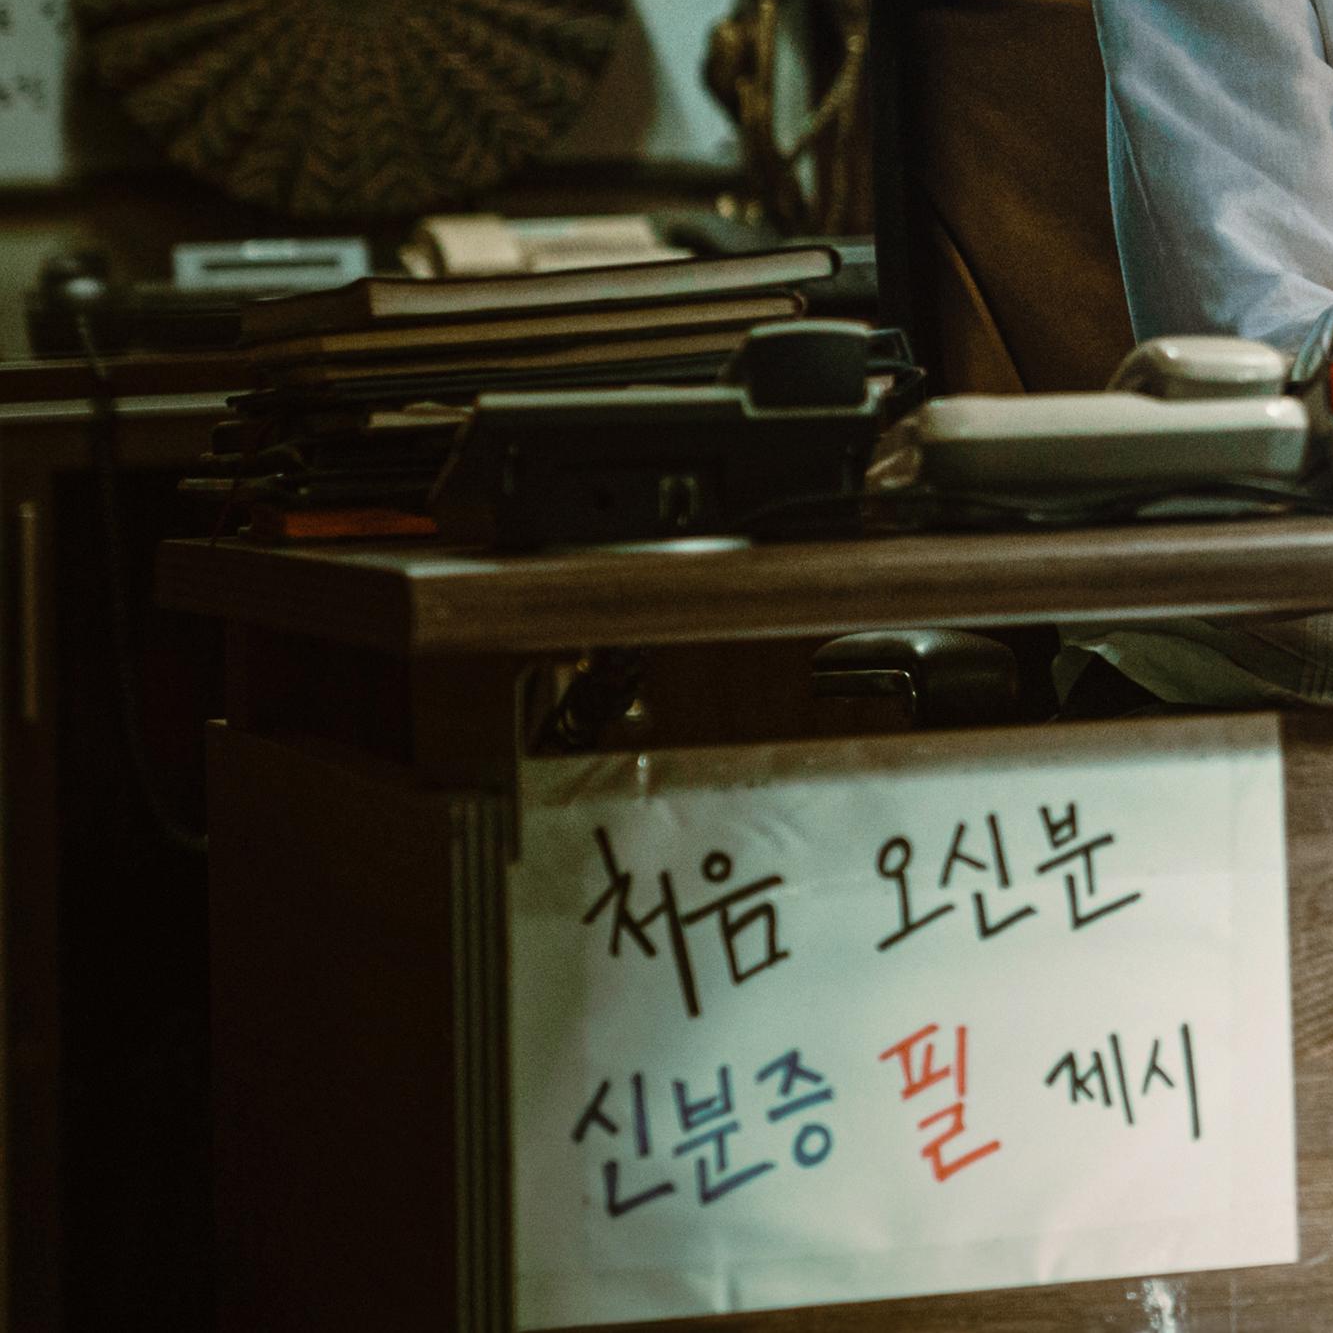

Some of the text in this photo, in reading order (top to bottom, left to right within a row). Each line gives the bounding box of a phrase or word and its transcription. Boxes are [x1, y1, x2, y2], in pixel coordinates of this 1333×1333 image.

[583, 801, 1142, 1018] 처음 오신분
[571, 1022, 1202, 1219] 신분증 필 제시
